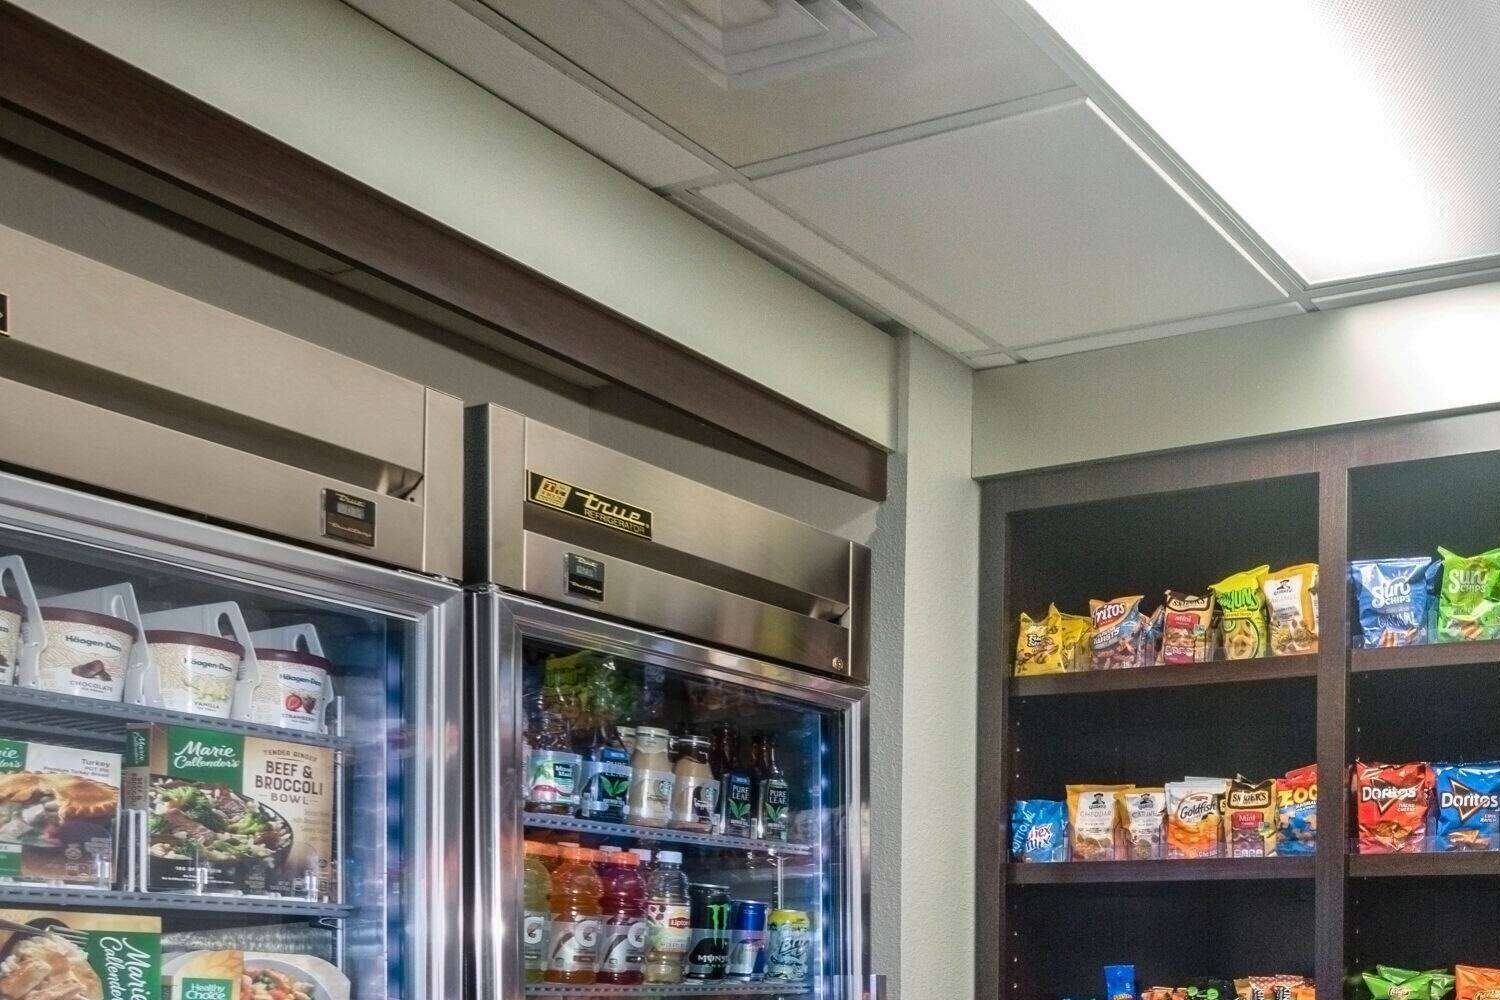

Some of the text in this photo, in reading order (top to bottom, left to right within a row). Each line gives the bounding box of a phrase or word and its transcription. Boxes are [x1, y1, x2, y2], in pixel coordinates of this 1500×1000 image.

[575, 491, 648, 525] true
[584, 509, 646, 535] REFRIGERATOR
[1449, 569, 1489, 594] Sun
[1459, 584, 1486, 593] CHIPS
[1372, 582, 1411, 609] Sun
[1384, 596, 1410, 606] CHIPS
[174, 739, 236, 759] Marie
[81, 758, 111, 768] Turkey
[173, 756, 240, 769] Callender's
[266, 760, 314, 779] BEEF &
[255, 774, 323, 796] BROCCOLI
[769, 788, 787, 798] PURE
[1362, 785, 1417, 801] Doritos
[270, 792, 309, 806] BOWL
[1441, 792, 1500, 809] Doritos
[1179, 801, 1217, 820] Goldfish
[185, 990, 226, 1000] Choice
[191, 983, 226, 994] Healthy
